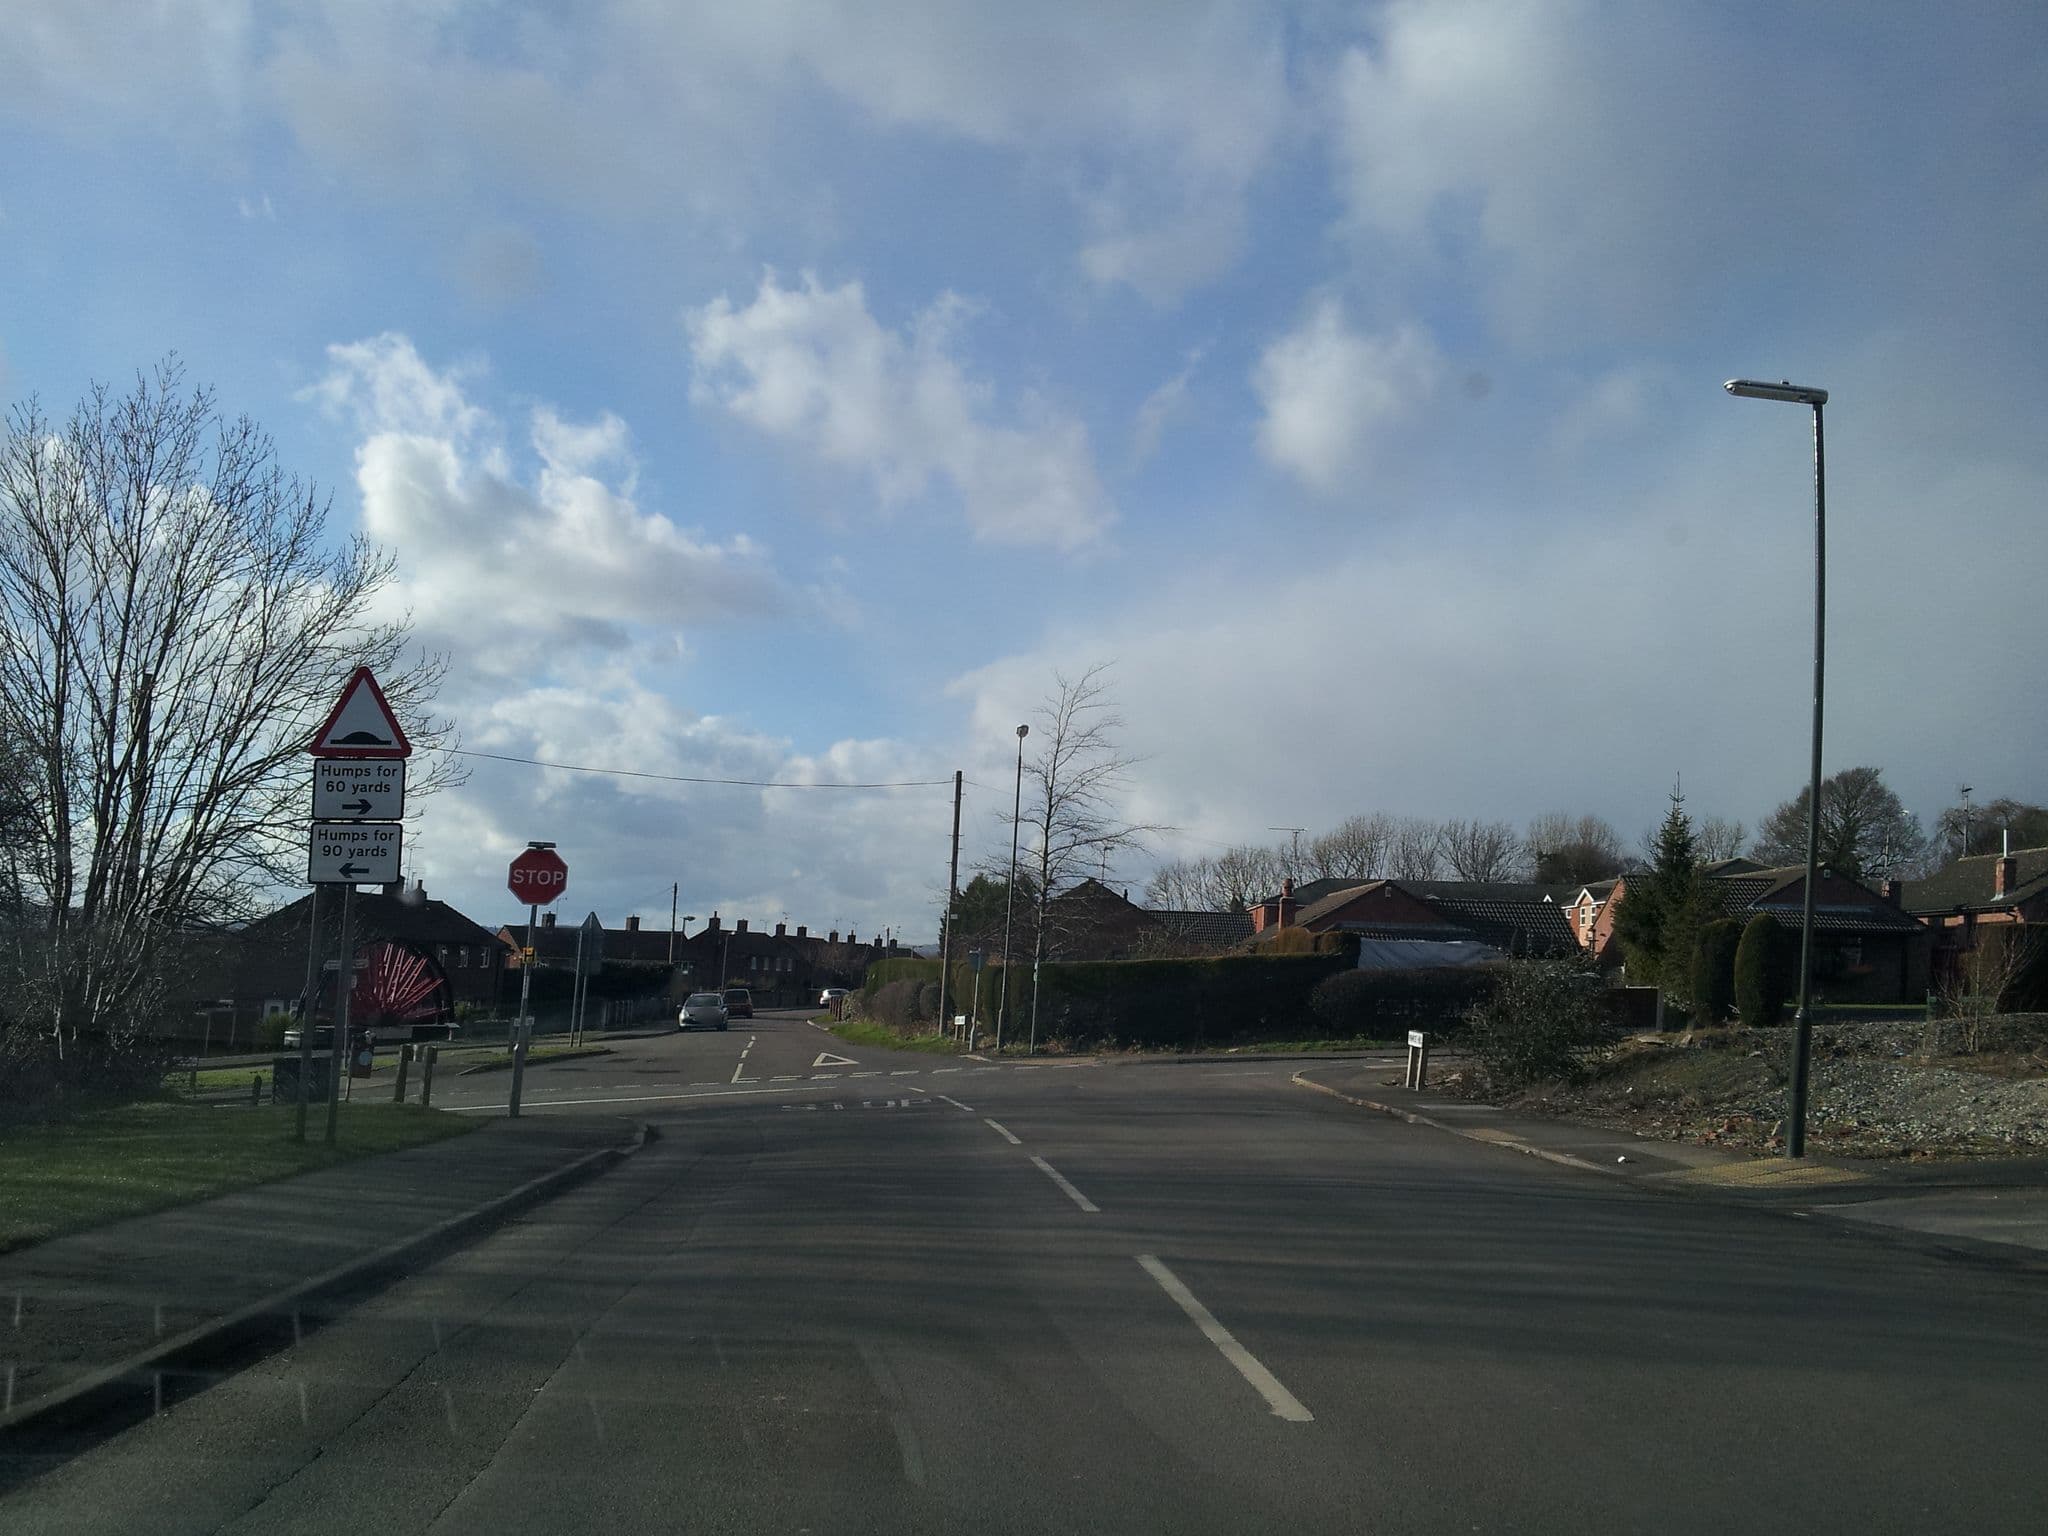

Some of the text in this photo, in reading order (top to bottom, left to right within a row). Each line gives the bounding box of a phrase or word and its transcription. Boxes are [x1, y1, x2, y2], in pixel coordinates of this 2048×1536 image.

[321, 765, 397, 778] Humps for
[326, 781, 391, 795] 60 yards
[318, 829, 394, 842] Humps for
[322, 845, 388, 859] 90 yards
[512, 869, 564, 885] STOP
